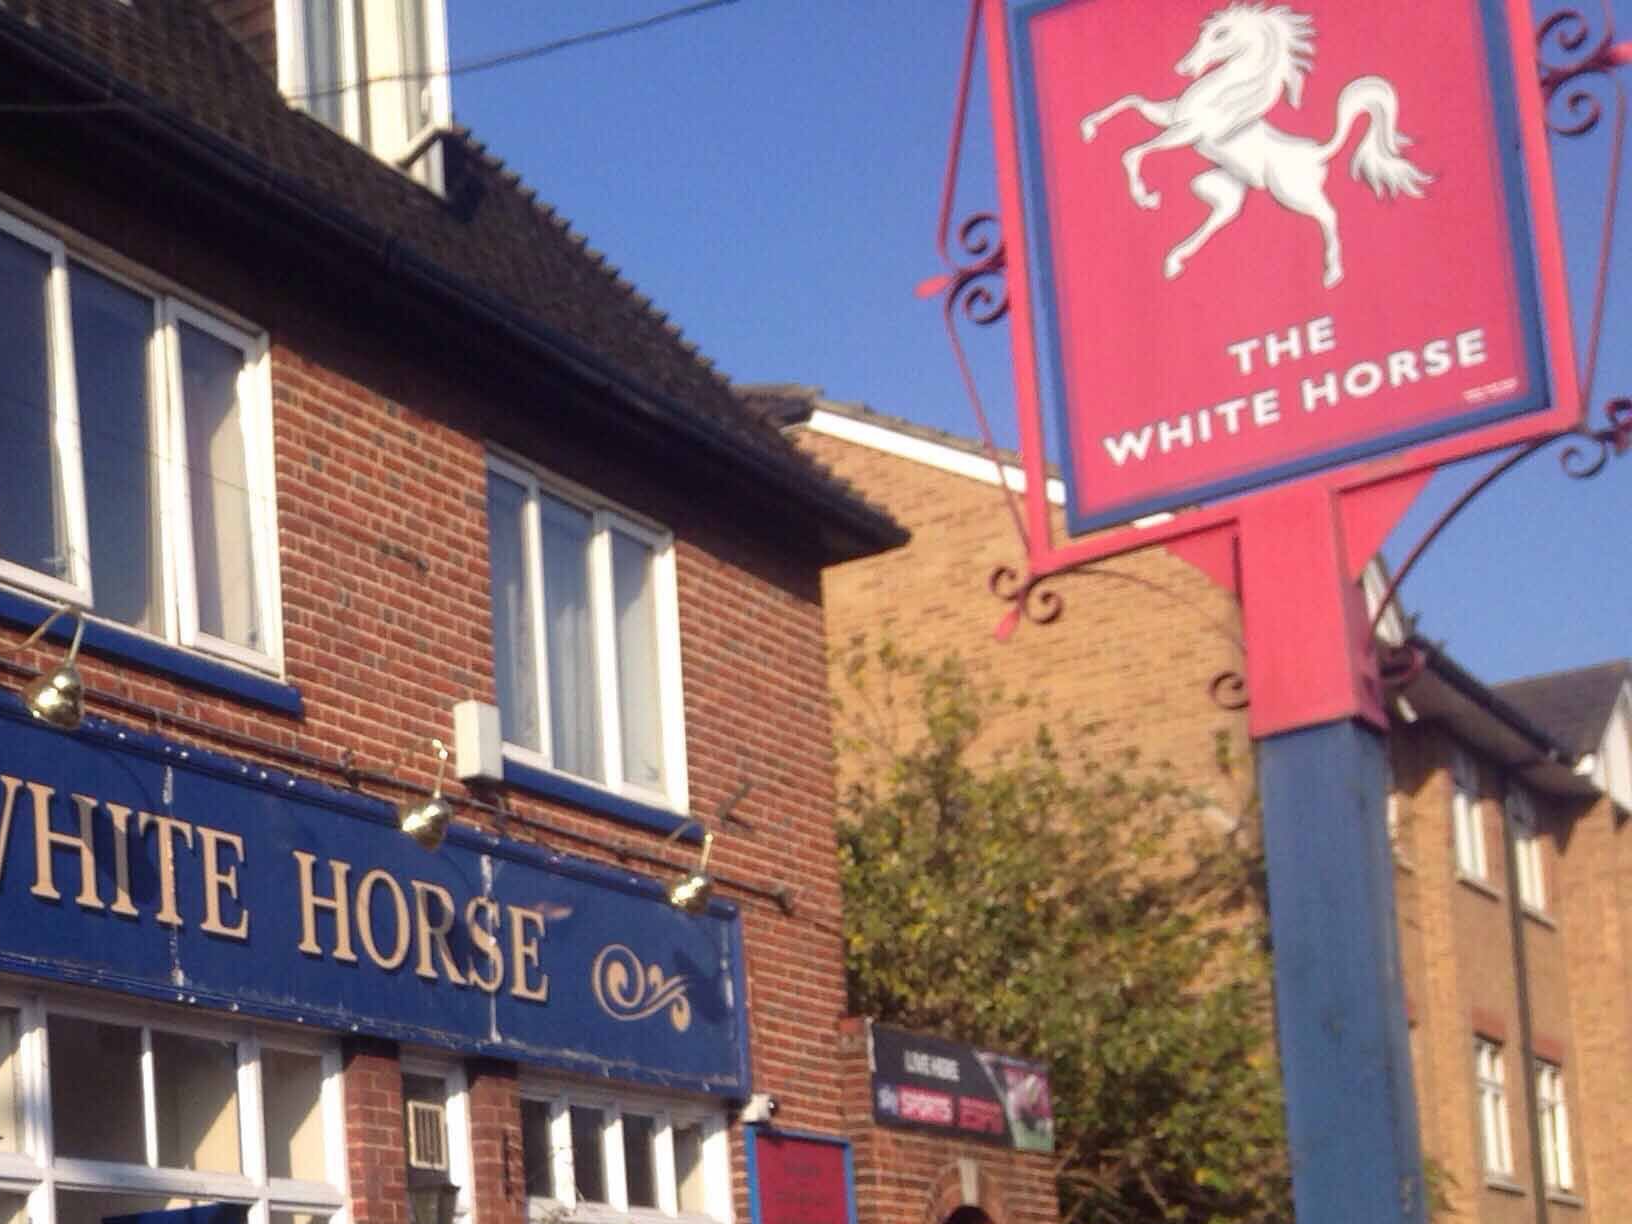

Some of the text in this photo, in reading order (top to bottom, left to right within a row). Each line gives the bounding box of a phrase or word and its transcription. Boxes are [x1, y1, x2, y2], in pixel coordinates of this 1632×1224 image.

[1104, 328, 1486, 465] WHITE HORSE
[1228, 316, 1336, 374] THE
[292, 850, 549, 1001] HORSE
